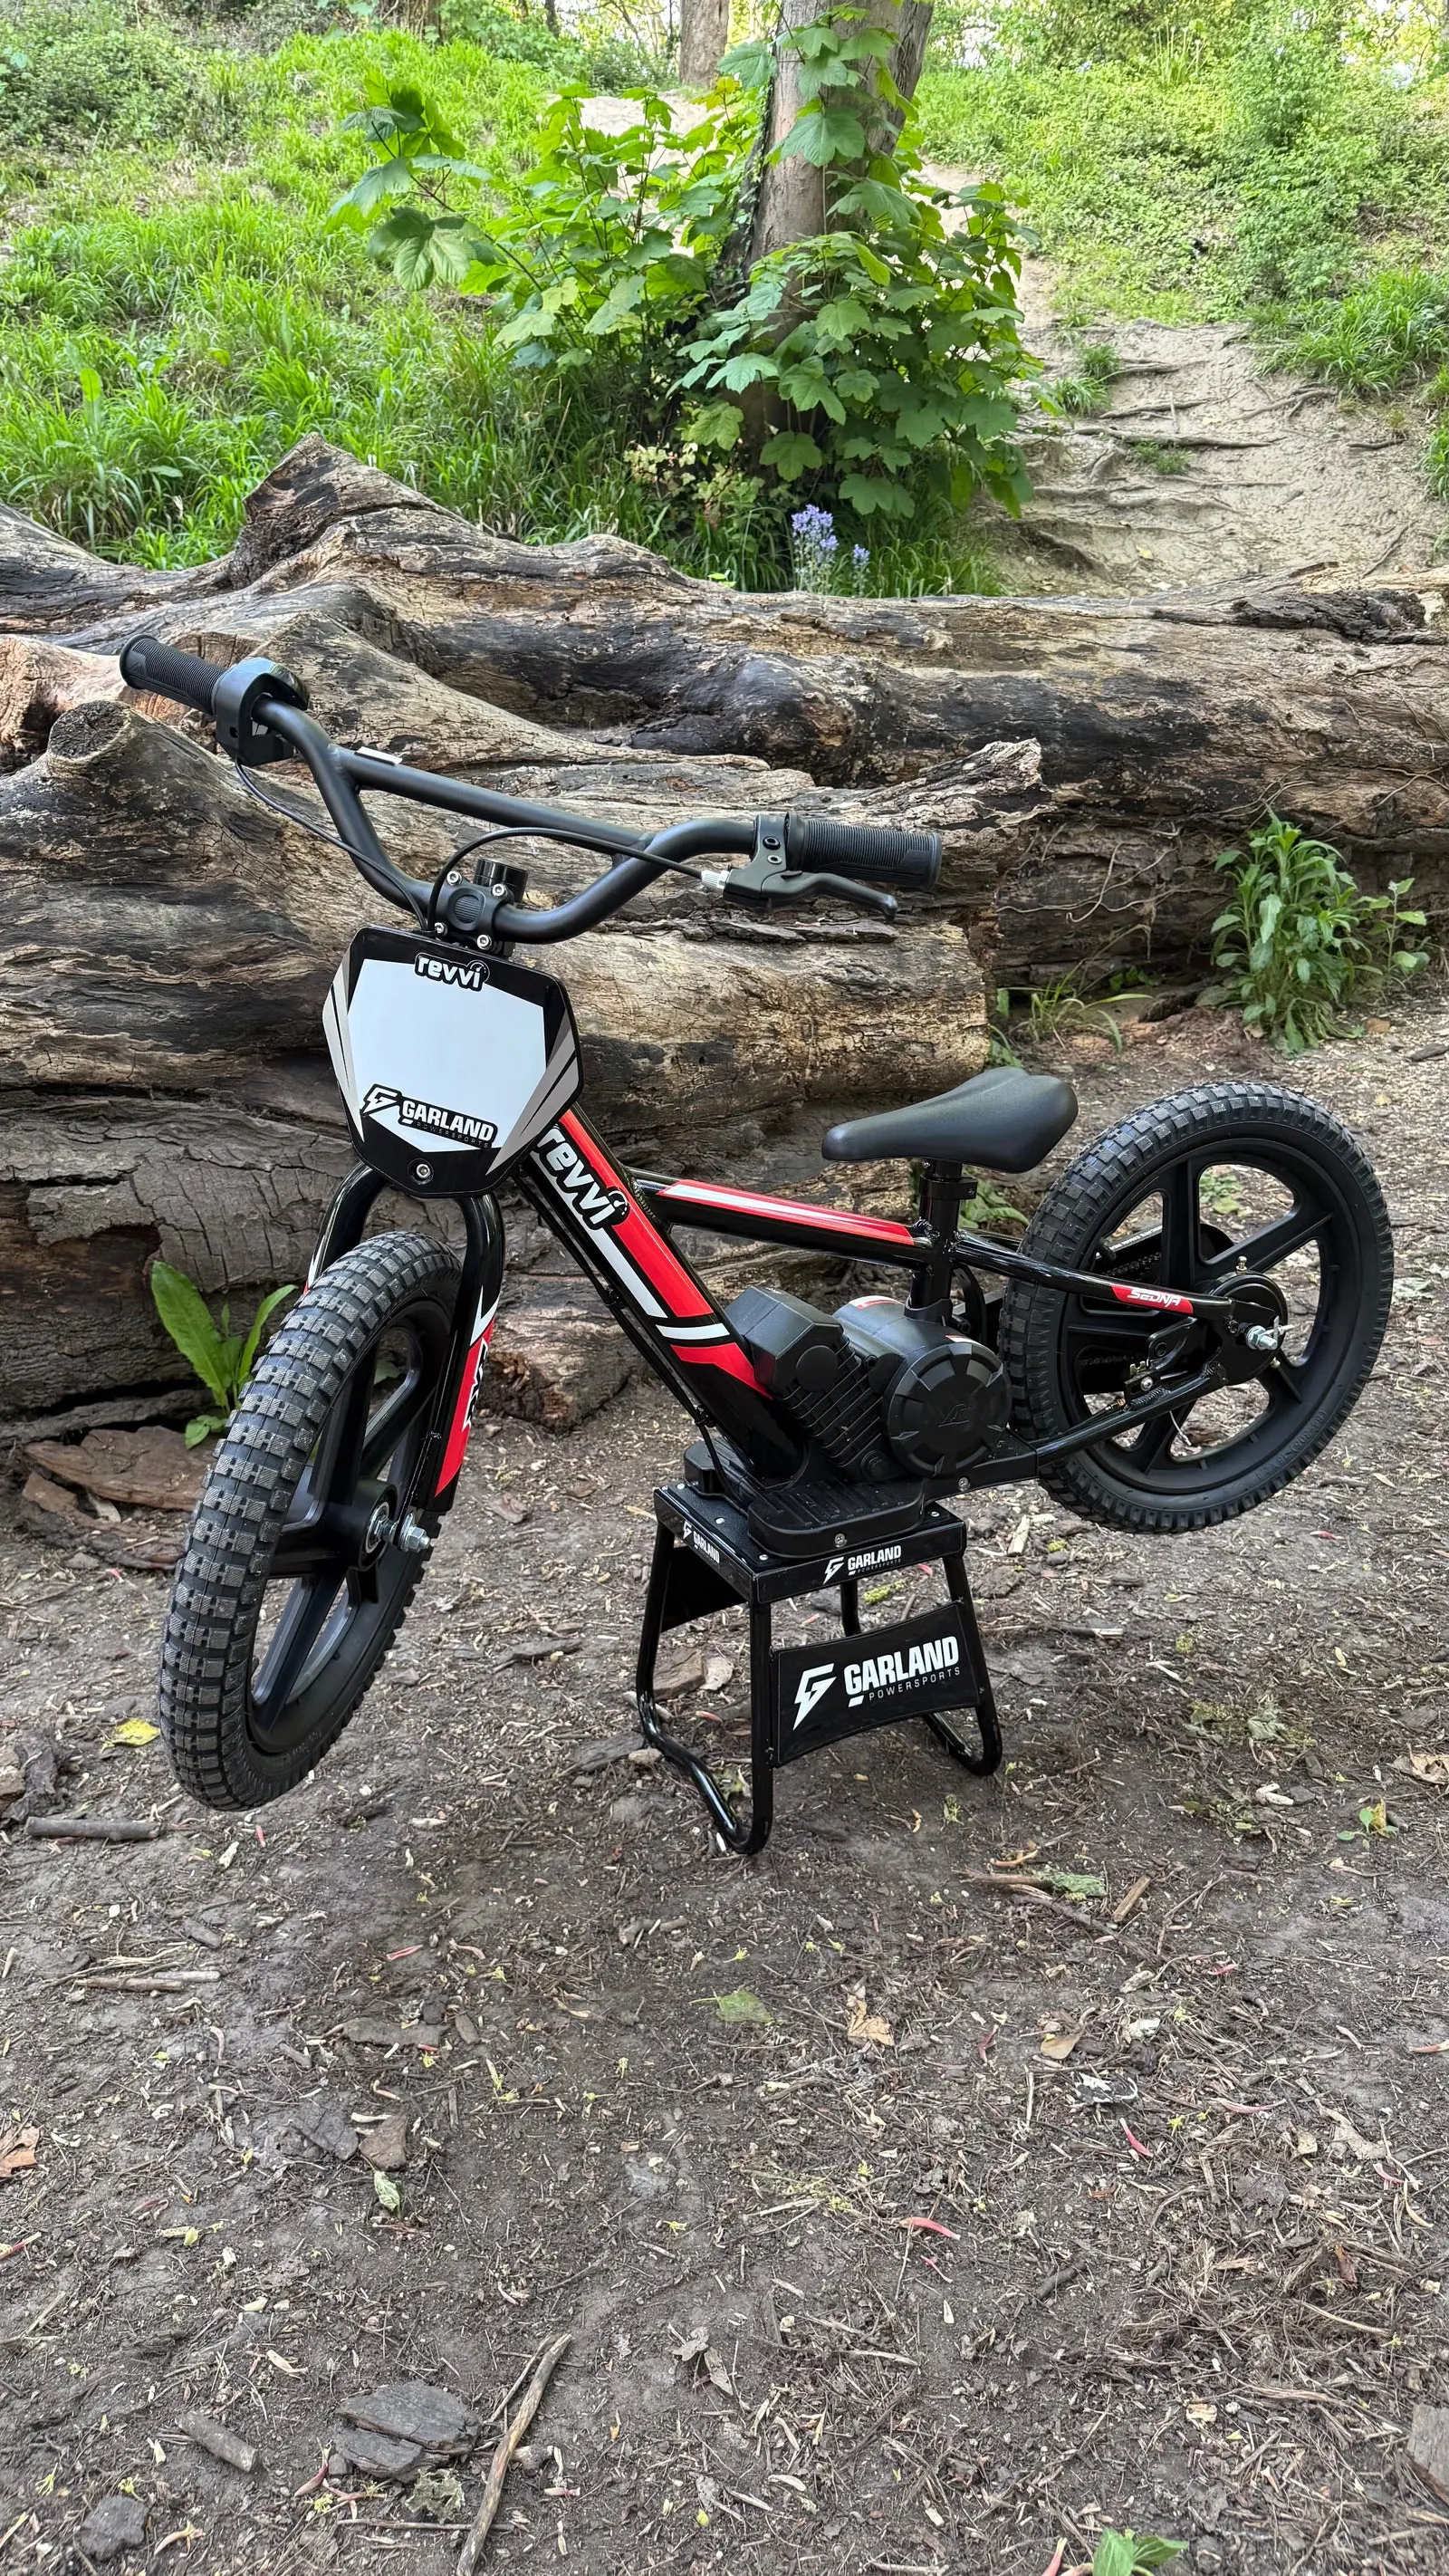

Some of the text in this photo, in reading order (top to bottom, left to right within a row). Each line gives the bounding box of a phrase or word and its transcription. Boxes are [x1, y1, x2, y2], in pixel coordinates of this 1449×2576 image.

[417, 956, 485, 989] revvi
[402, 1100, 494, 1141] GARLAND
[537, 1128, 625, 1225] revvi
[848, 1545, 902, 1571] GARLAND
[844, 1636, 959, 1696] GARLAND
[868, 1667, 960, 1701] POWERSPORTS
